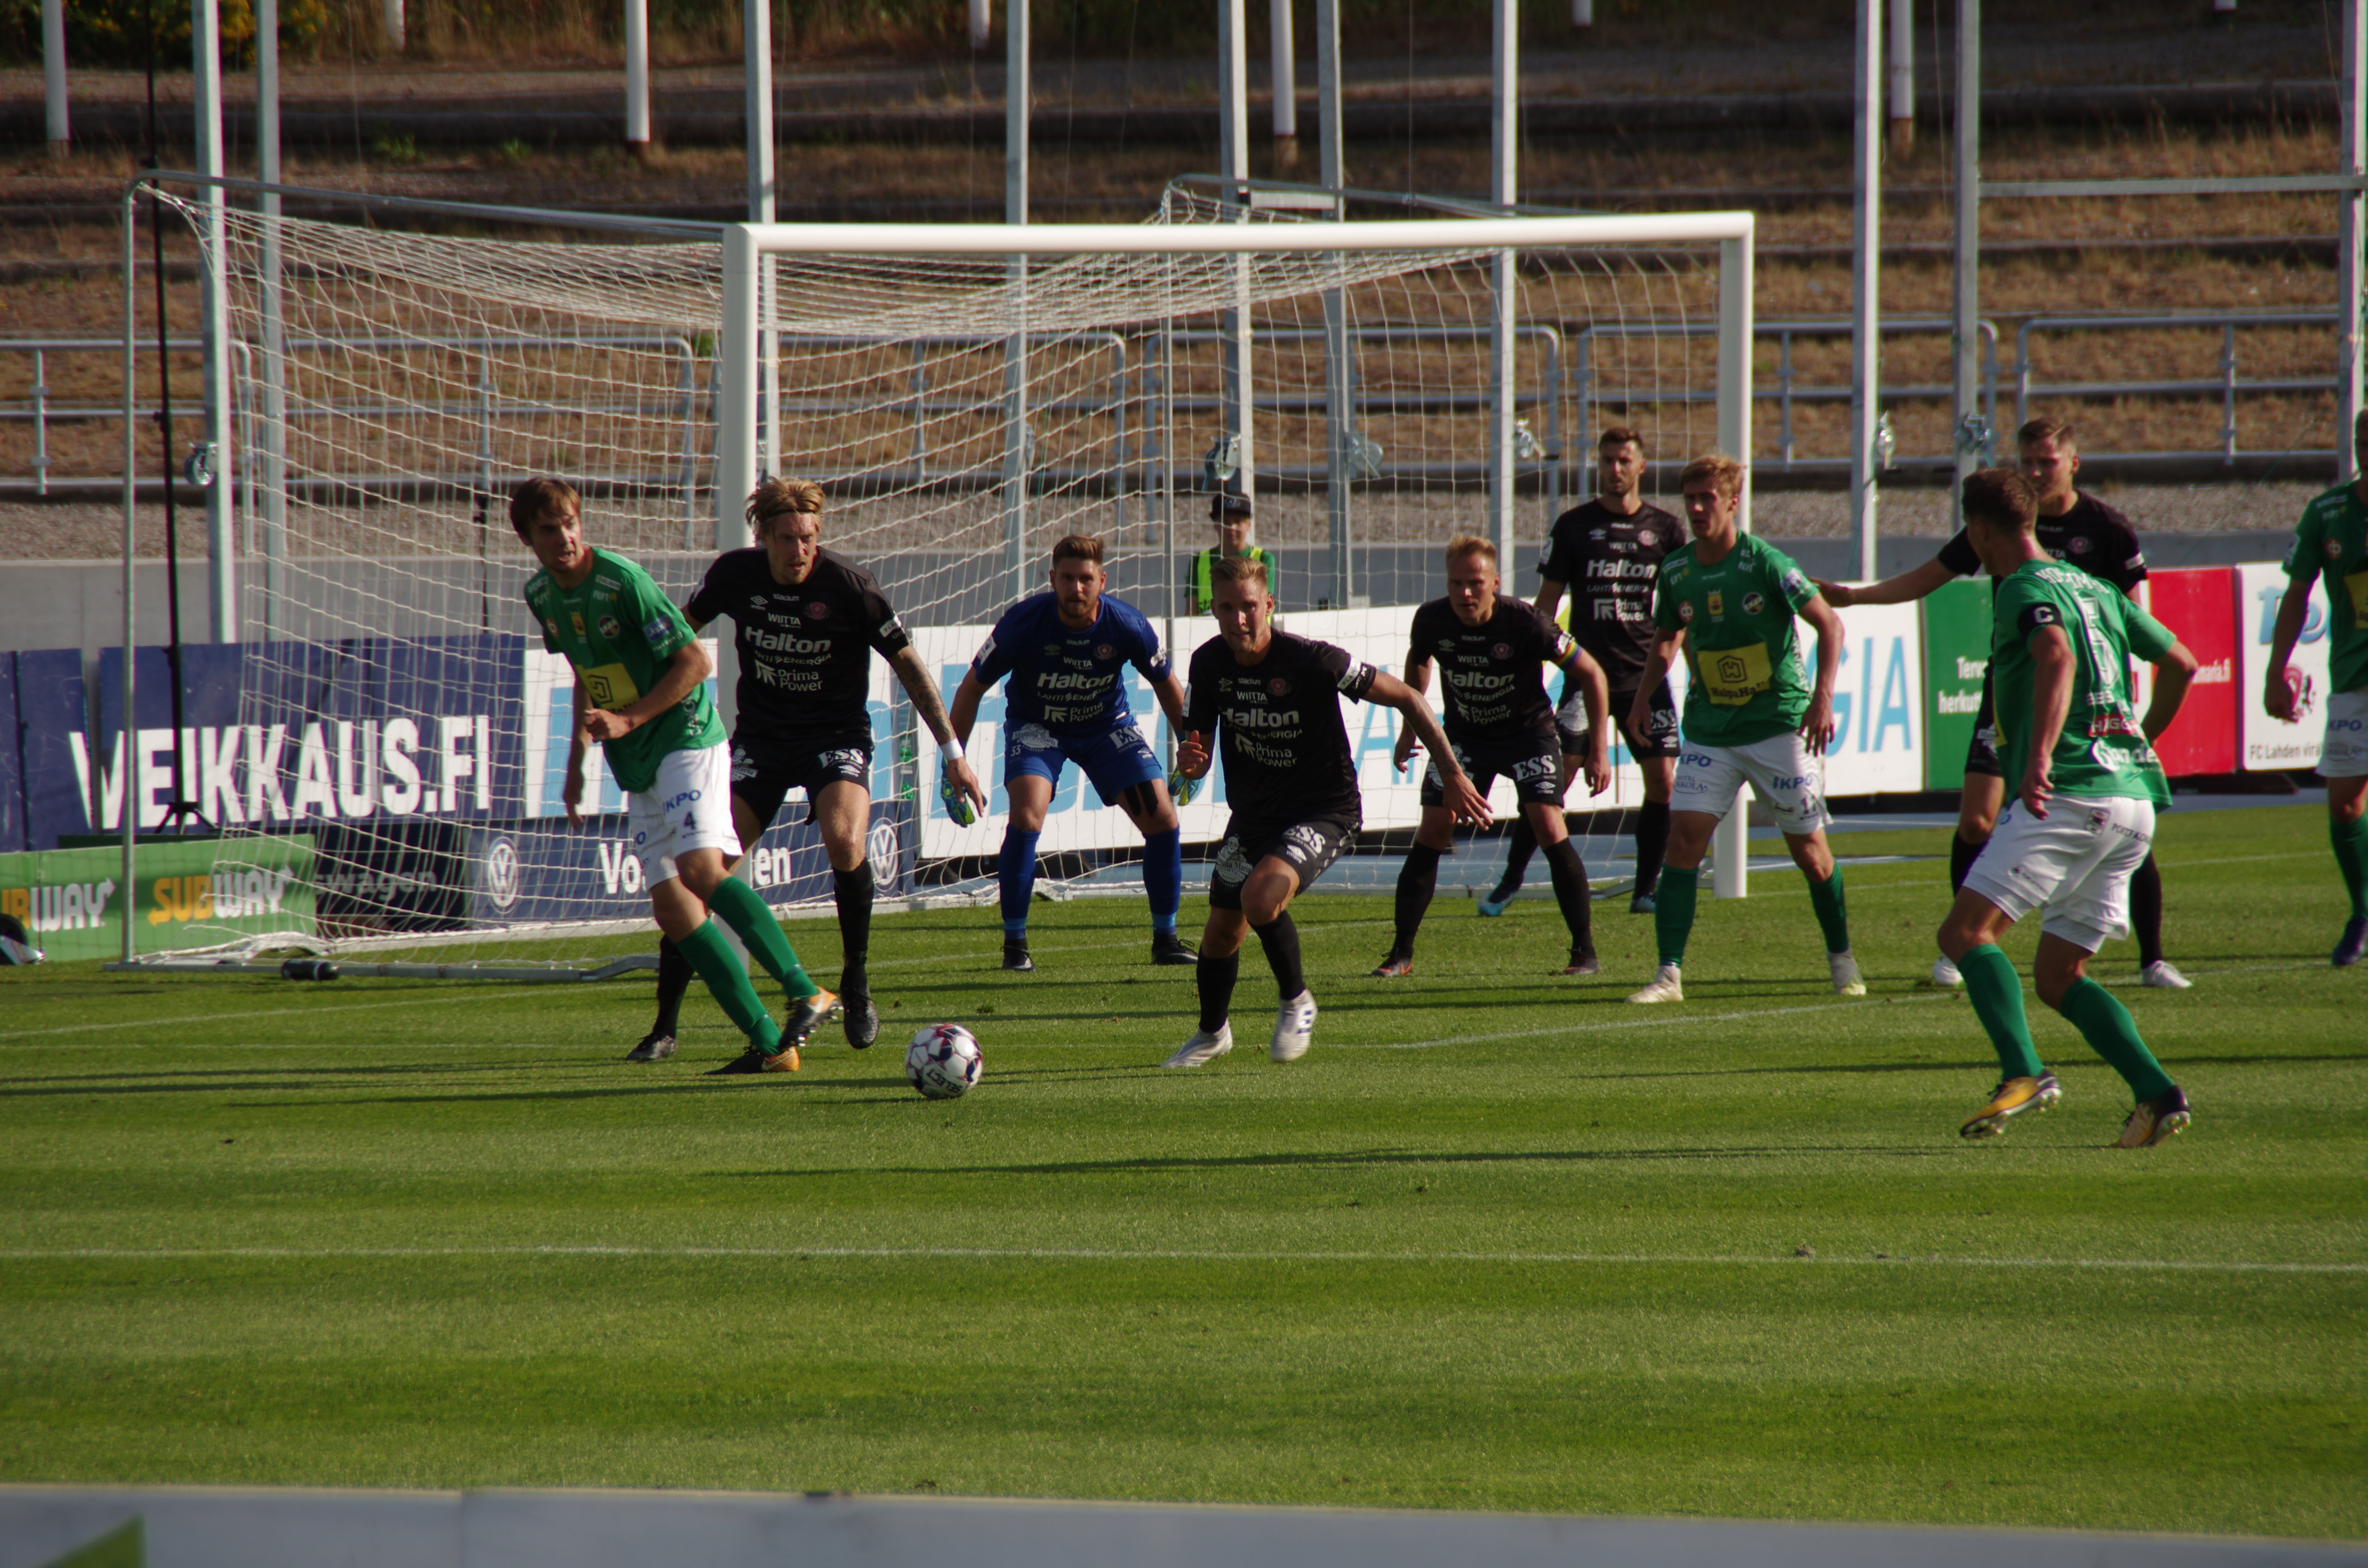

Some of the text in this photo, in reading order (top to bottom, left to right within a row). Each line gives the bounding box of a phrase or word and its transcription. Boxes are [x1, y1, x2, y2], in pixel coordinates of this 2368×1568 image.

[1587, 559, 1658, 578] Halton
[773, 593, 800, 601] stadium
[768, 612, 802, 626] WIITTA
[2034, 607, 2053, 624] C
[745, 625, 832, 654] Halton
[754, 649, 773, 663] AHTI
[1063, 656, 1093, 667] WIITTA
[1457, 654, 1489, 664] WIITTA
[777, 669, 819, 682] Prima
[1956, 657, 1988, 679] Terv
[780, 678, 823, 692] Power
[1036, 672, 1115, 689] Halton
[1238, 677, 1261, 686] stadium
[1236, 690, 1268, 701] WIITTA
[1472, 684, 1515, 702] ENERGIA
[1071, 701, 1104, 716] Prima
[1471, 704, 1507, 717] Prima
[1472, 709, 1512, 724] Power
[1011, 744, 1022, 757] 33
[1256, 741, 1293, 758] Prima
[818, 748, 864, 769] ESS
[1256, 751, 1297, 768] Power
[69, 714, 491, 830] VEIKKAUS.FI
[1512, 755, 1556, 782] ESS
[684, 811, 696, 830] 4
[315, 870, 437, 901] swagen
[148, 865, 295, 926] SUBWAY
[1, 877, 116, 932] BWAY
[926, 1068, 963, 1093] SELECT
